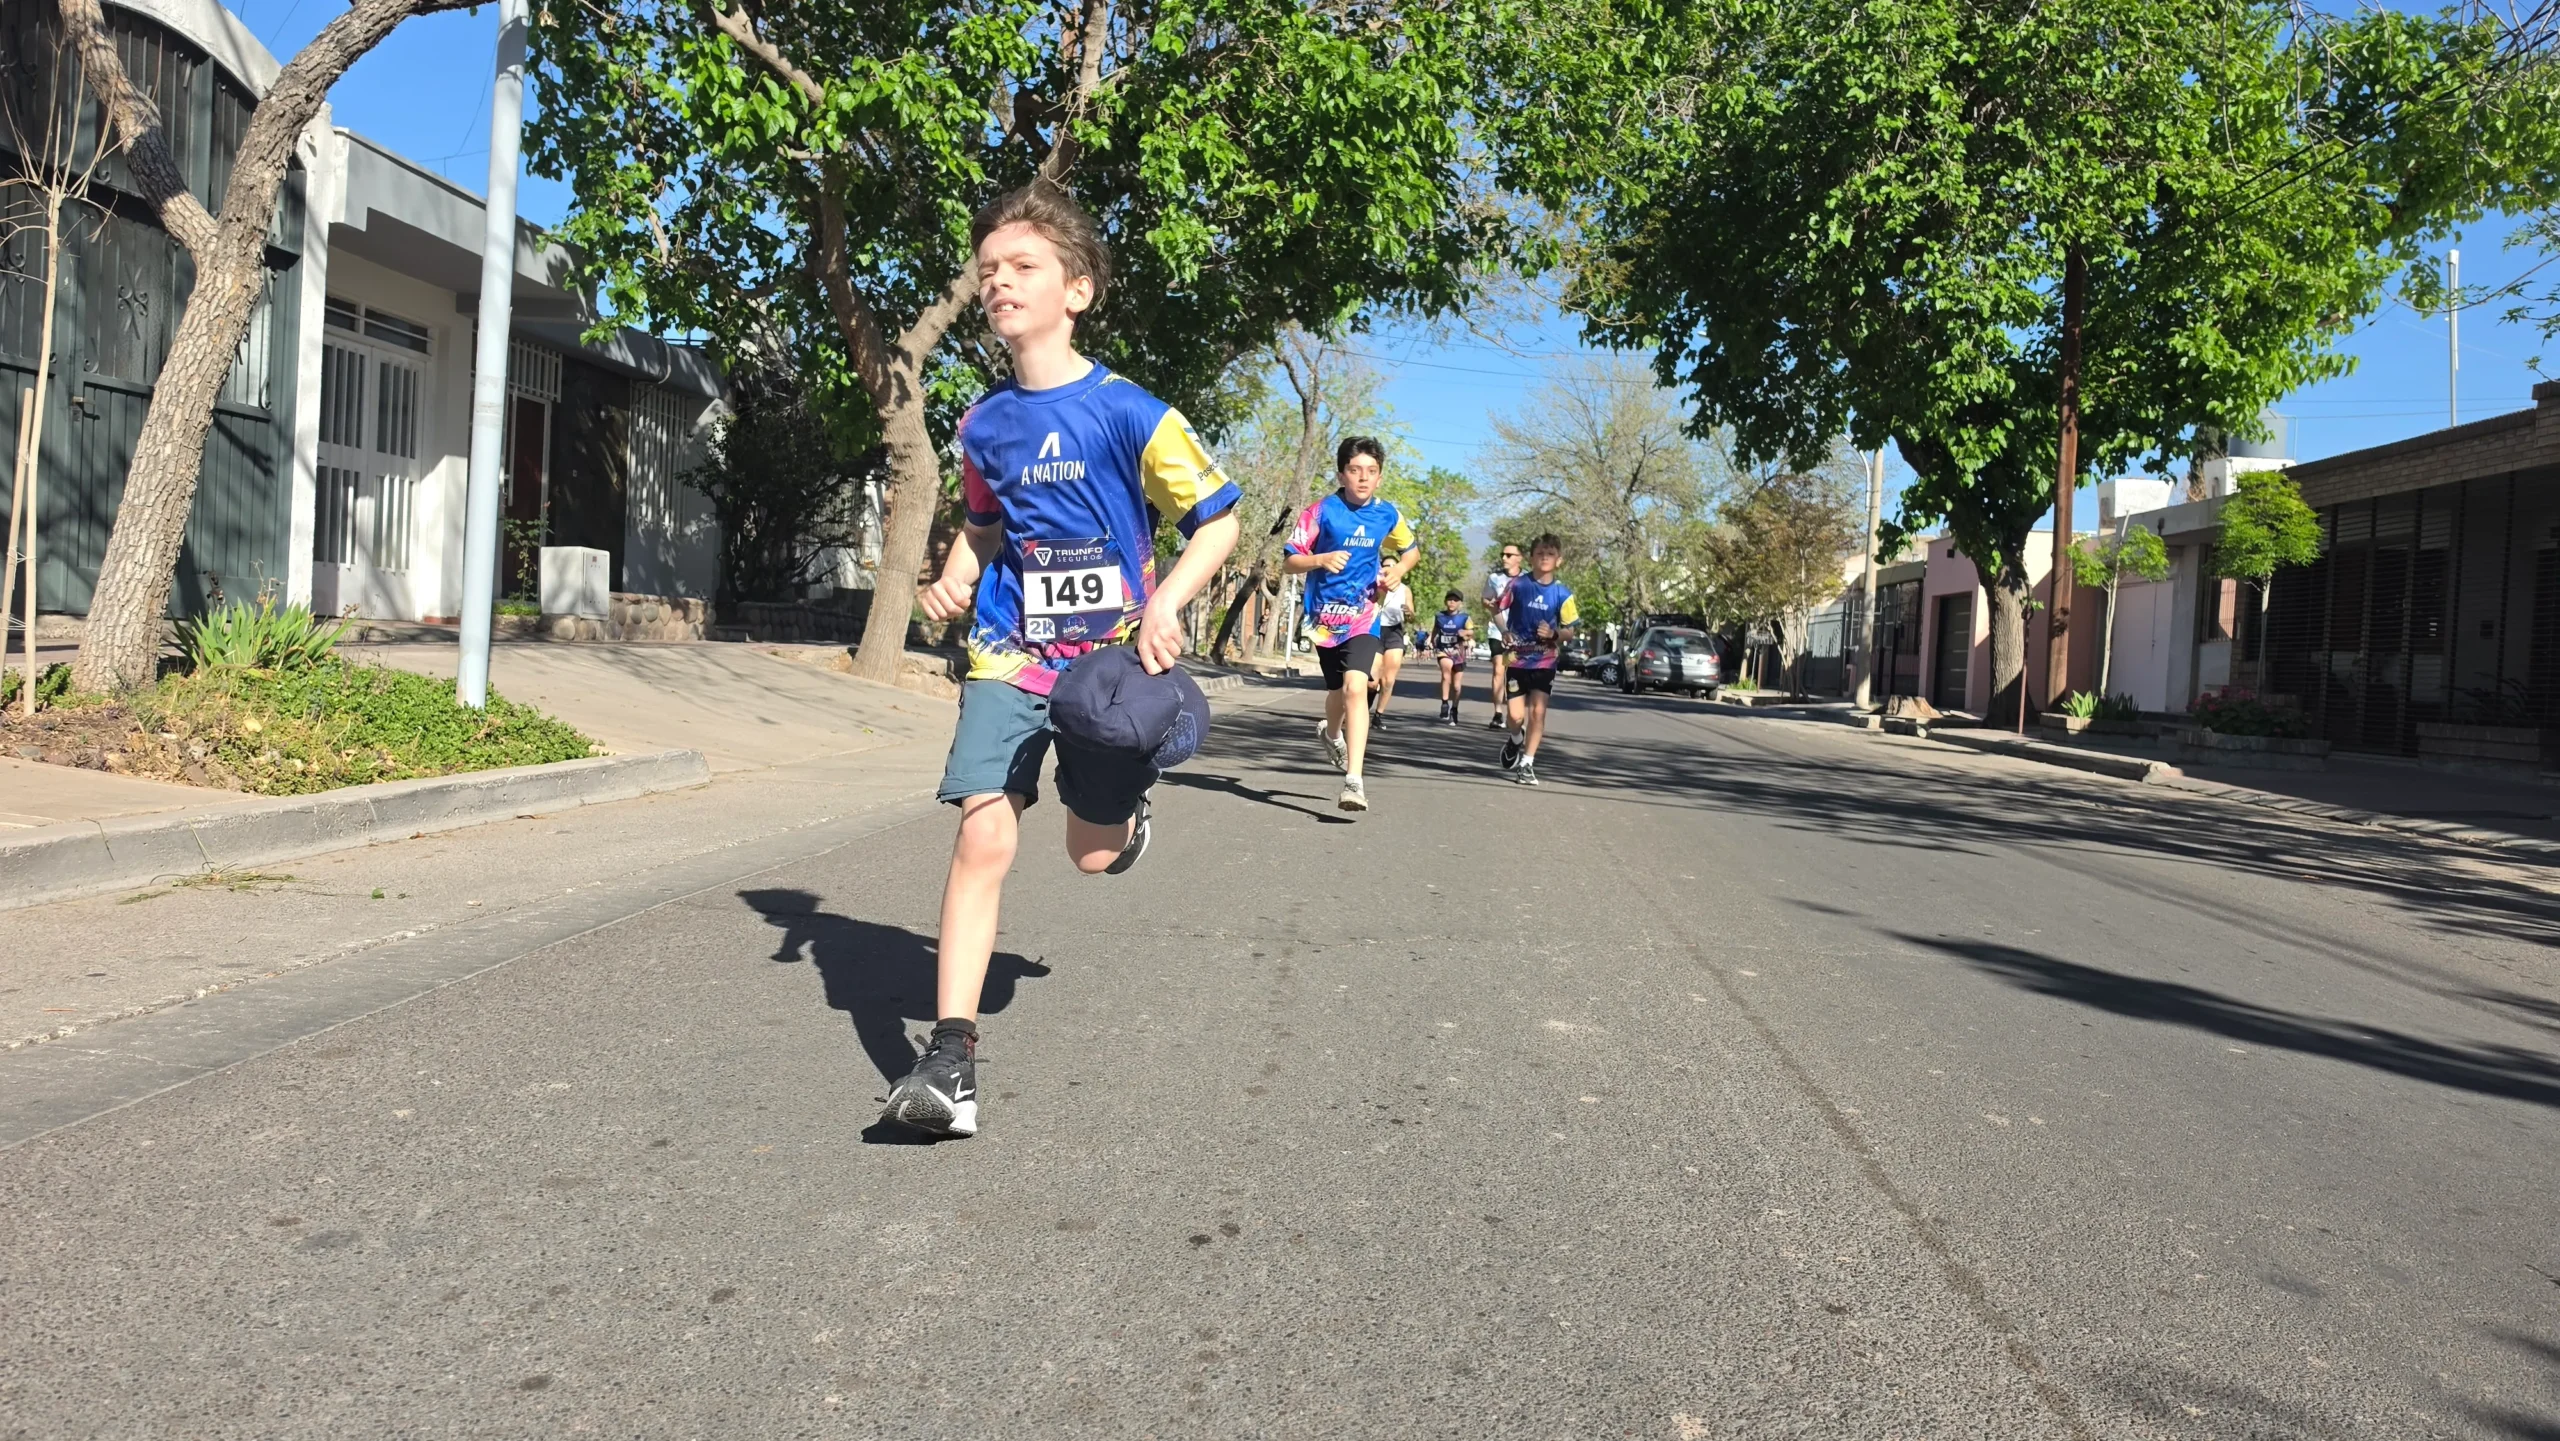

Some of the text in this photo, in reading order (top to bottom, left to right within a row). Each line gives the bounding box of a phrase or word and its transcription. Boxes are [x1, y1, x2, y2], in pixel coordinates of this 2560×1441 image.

[1021, 460, 1085, 486] A NATION
[1343, 537, 1375, 548] A NATION
[1055, 546, 1103, 556] TRIUNFO
[1041, 573, 1103, 607] 149
[1321, 603, 1359, 616] KIDS
